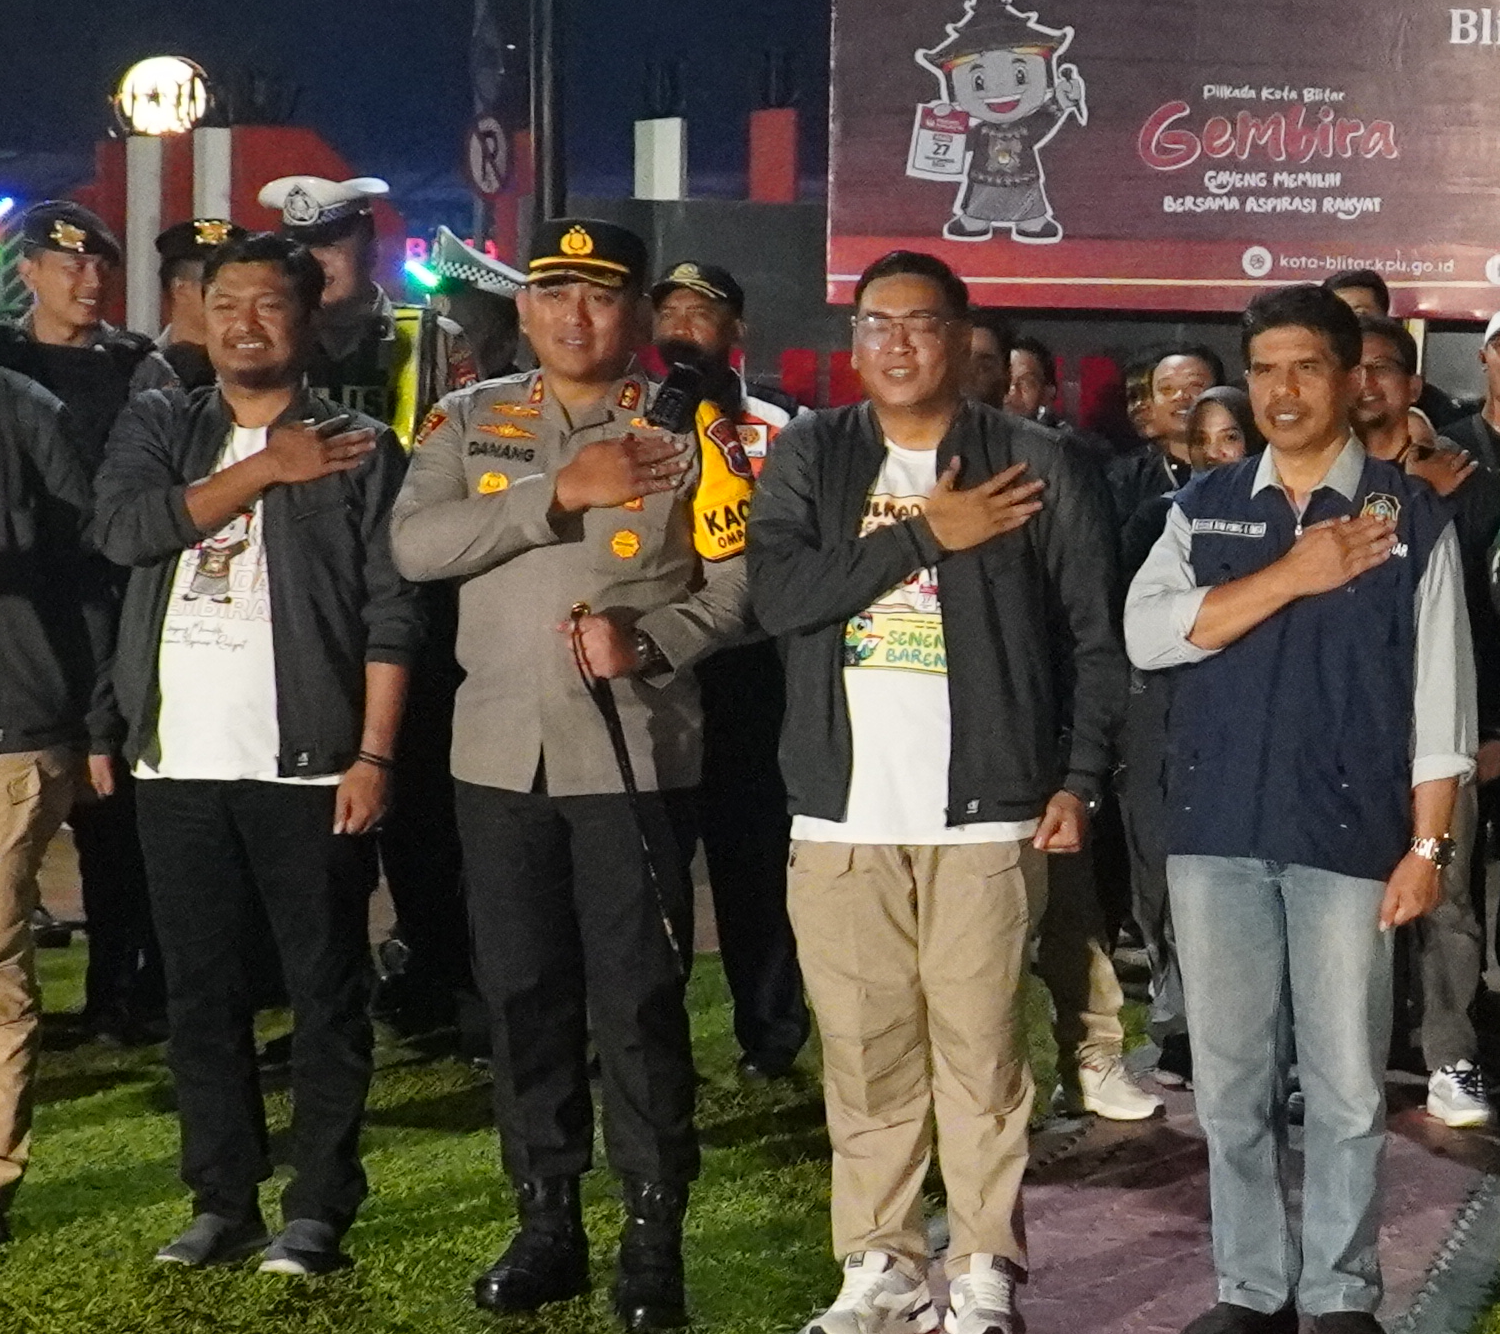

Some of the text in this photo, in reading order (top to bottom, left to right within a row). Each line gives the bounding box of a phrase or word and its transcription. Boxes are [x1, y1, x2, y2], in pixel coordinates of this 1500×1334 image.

[1203, 84, 1346, 102] Pilkada Kota Blitar
[1138, 100, 1398, 170] Gembira
[933, 143, 950, 156] 27
[1163, 196, 1382, 219] BERSAMA ASPIRASI RAKYAT
[886, 630, 944, 649] SENEN
[886, 648, 946, 668] BAREN
